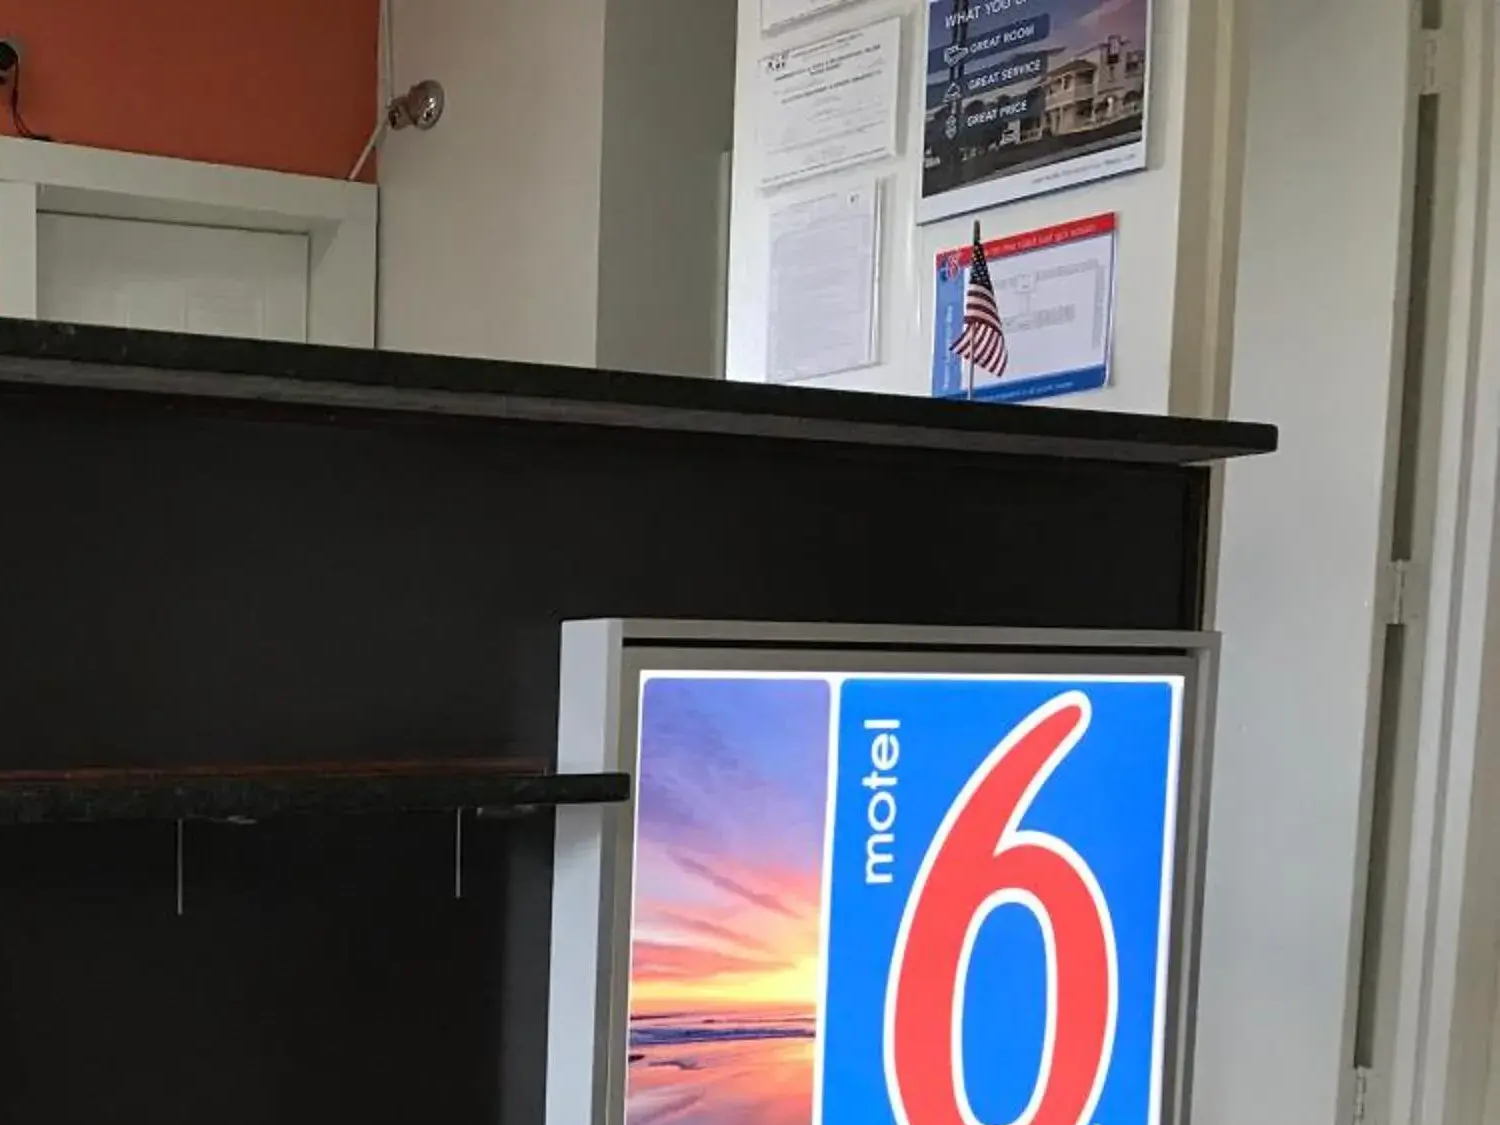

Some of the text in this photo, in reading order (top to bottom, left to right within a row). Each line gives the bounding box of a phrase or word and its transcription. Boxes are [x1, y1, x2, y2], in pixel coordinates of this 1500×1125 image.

[944, 5, 981, 29] WHAT
[969, 24, 1035, 53] GREAT ROOM
[967, 58, 1041, 90] GREAT SERVICE
[967, 99, 1028, 127] GREAT PRICE
[864, 718, 900, 885] motel
